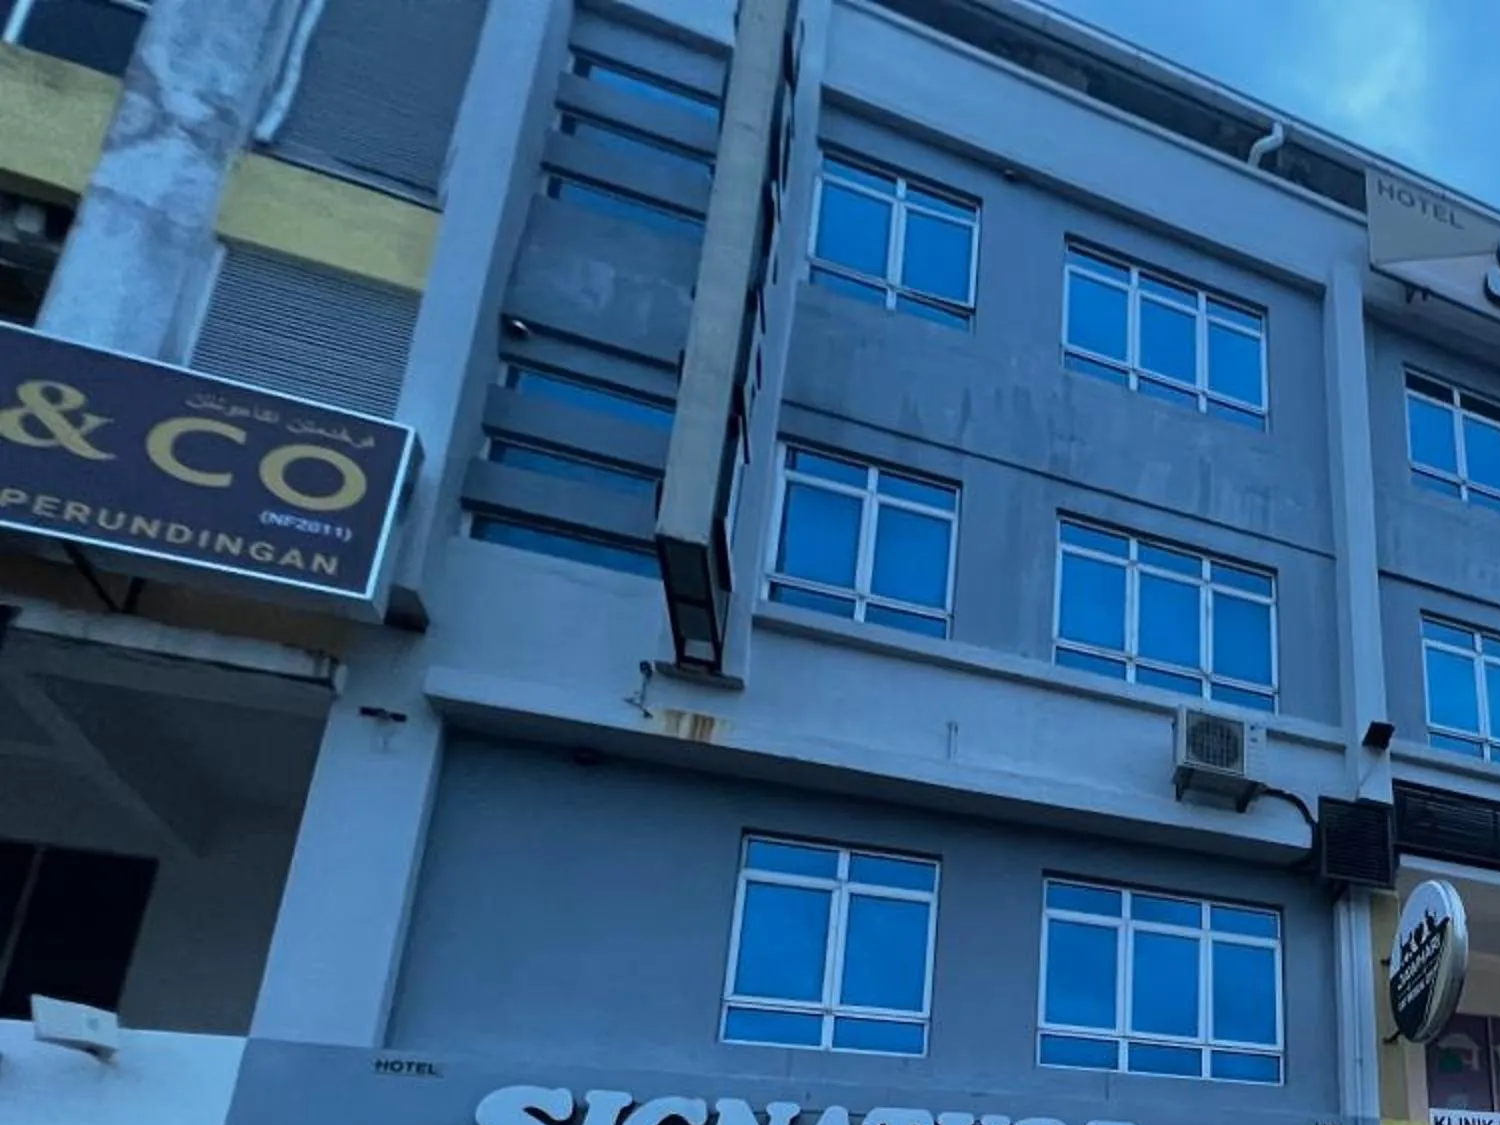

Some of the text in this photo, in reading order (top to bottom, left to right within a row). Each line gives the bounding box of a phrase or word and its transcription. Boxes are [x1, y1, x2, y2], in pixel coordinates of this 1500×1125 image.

[1377, 177, 1466, 231] HOTEL
[0, 380, 367, 511] & CO
[0, 487, 341, 577] PERUNDINGAN
[259, 511, 353, 542] (NF2011)
[375, 1059, 437, 1075] HOTEL
